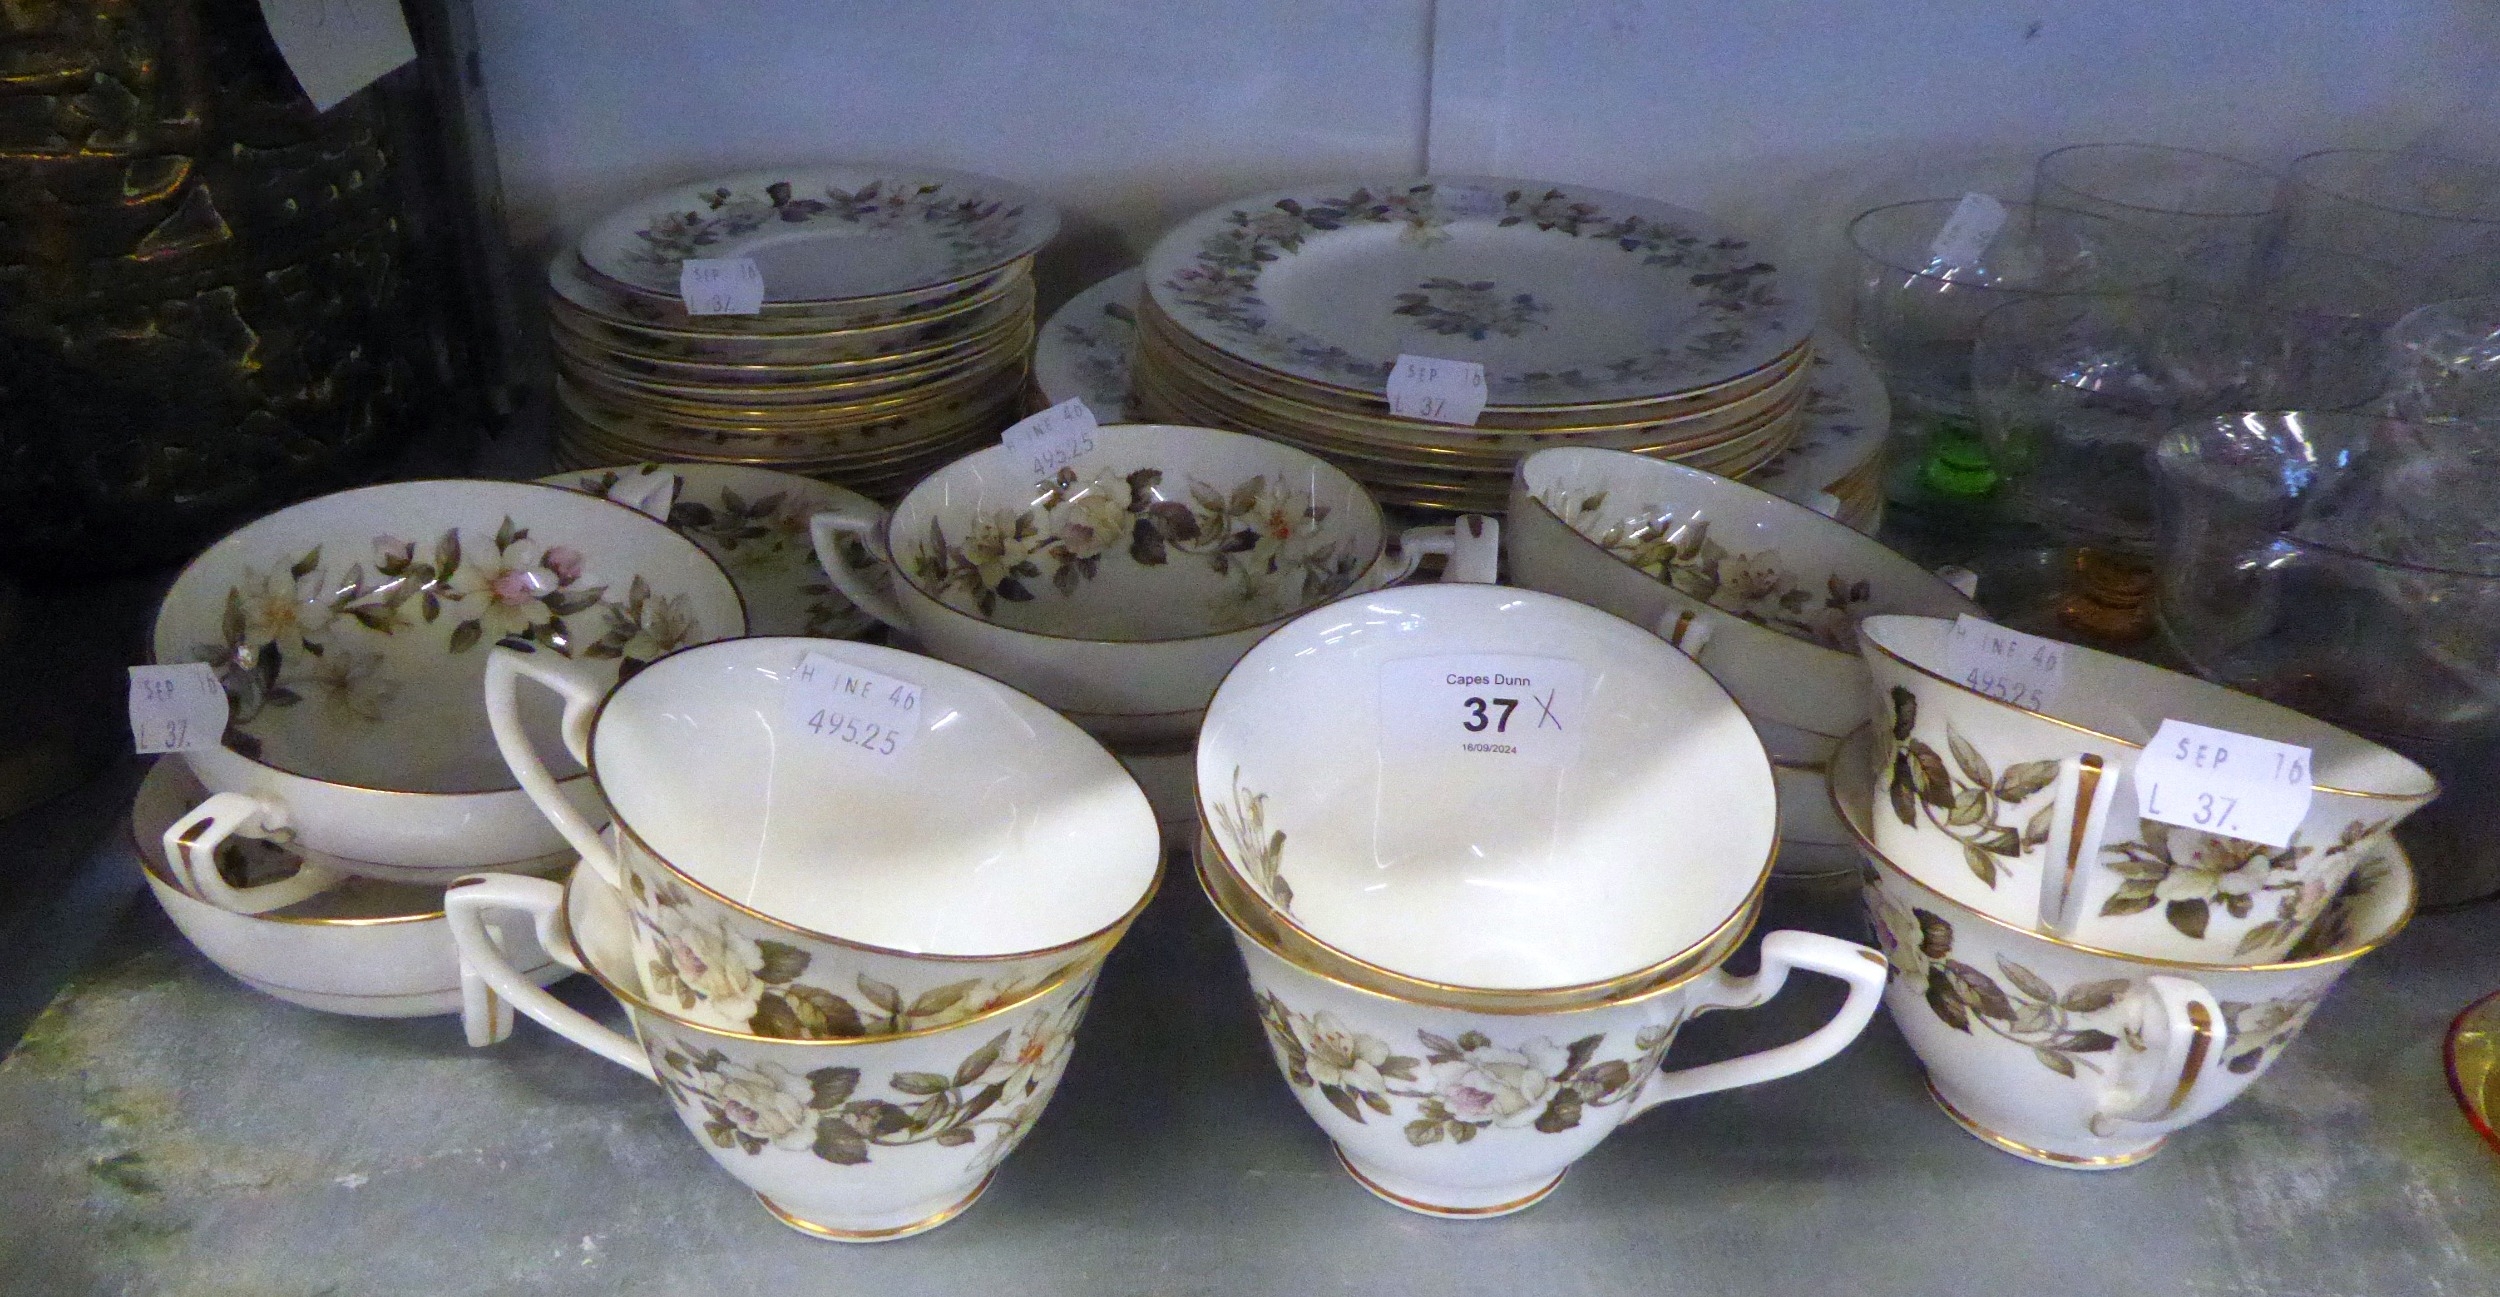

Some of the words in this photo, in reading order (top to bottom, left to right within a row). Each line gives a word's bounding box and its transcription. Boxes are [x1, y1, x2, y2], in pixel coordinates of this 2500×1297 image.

[693, 268, 717, 283] SEP
[1408, 364, 1437, 382] SEP
[144, 678, 174, 702] SEP
[1446, 673, 1490, 687] Capes
[1494, 673, 1531, 687] Dunn
[1463, 697, 1518, 733] 37
[808, 708, 899, 756] 495.25
[1462, 743, 1517, 755] 16/09/2024
[2174, 738, 2228, 769] SEP
[2274, 753, 2304, 784] 16
